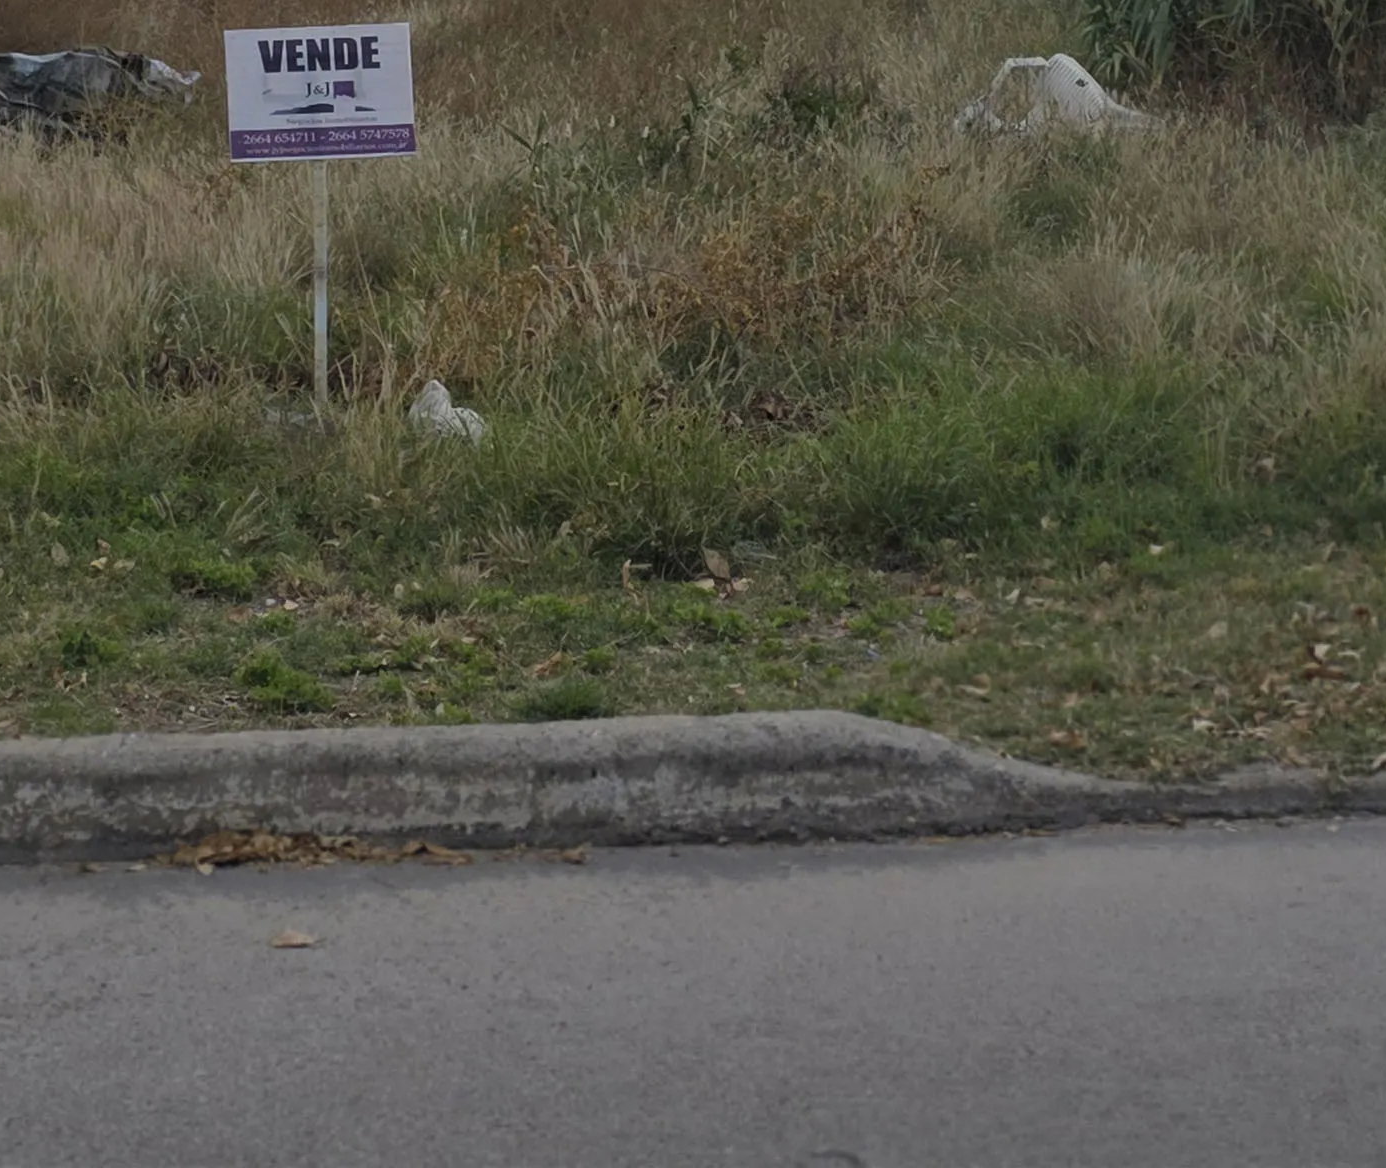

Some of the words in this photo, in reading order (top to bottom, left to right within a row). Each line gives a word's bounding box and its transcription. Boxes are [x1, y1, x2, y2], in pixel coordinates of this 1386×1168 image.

[258, 36, 381, 73] VENDE
[305, 81, 331, 98] J&J
[243, 134, 271, 145] 2664
[328, 130, 357, 142] 2664
